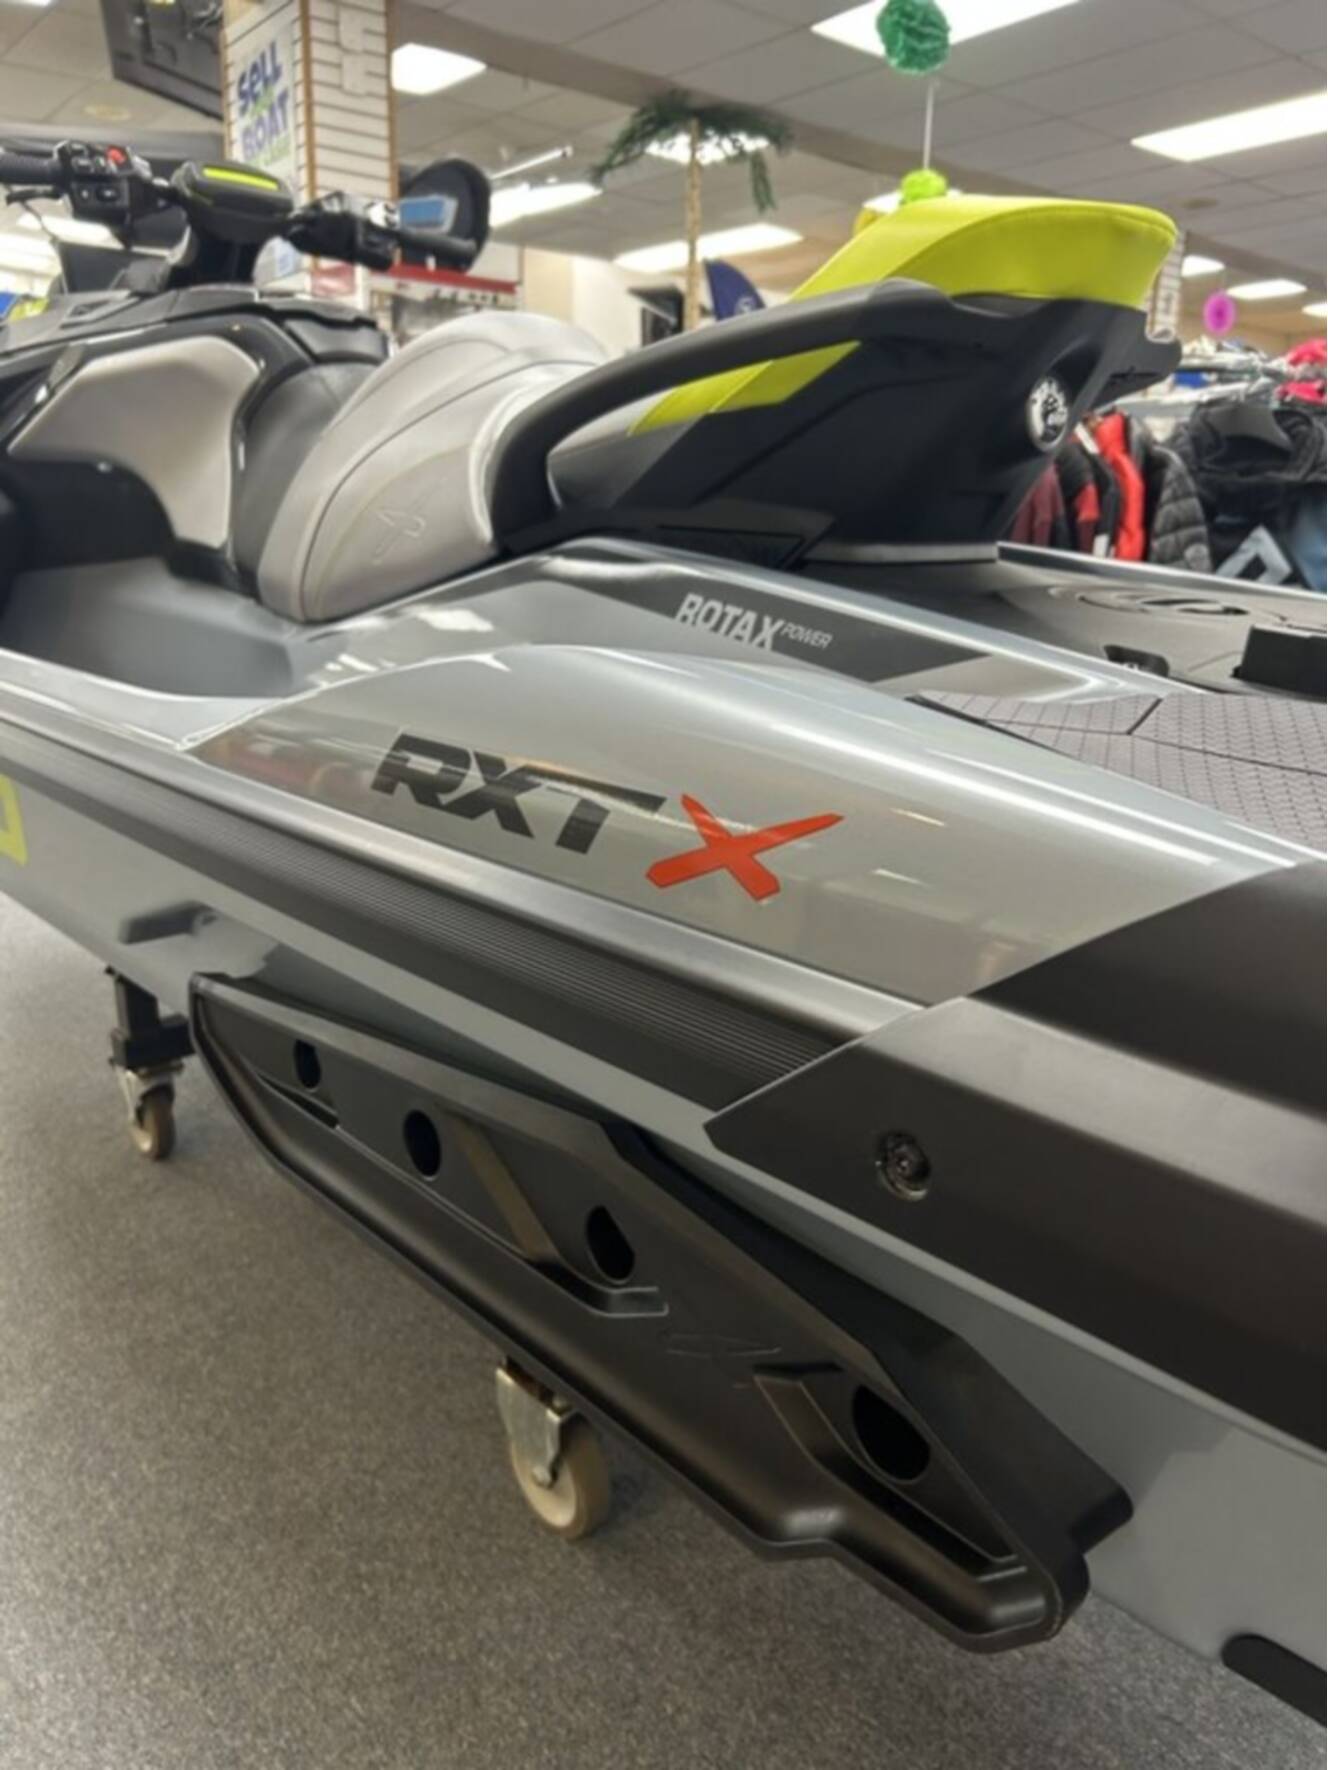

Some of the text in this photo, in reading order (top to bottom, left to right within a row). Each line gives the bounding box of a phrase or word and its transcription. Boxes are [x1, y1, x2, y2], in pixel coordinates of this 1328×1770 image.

[242, 88, 288, 160] BOAT
[675, 592, 833, 651] ROTAX POWER
[370, 733, 845, 902] RXT X
